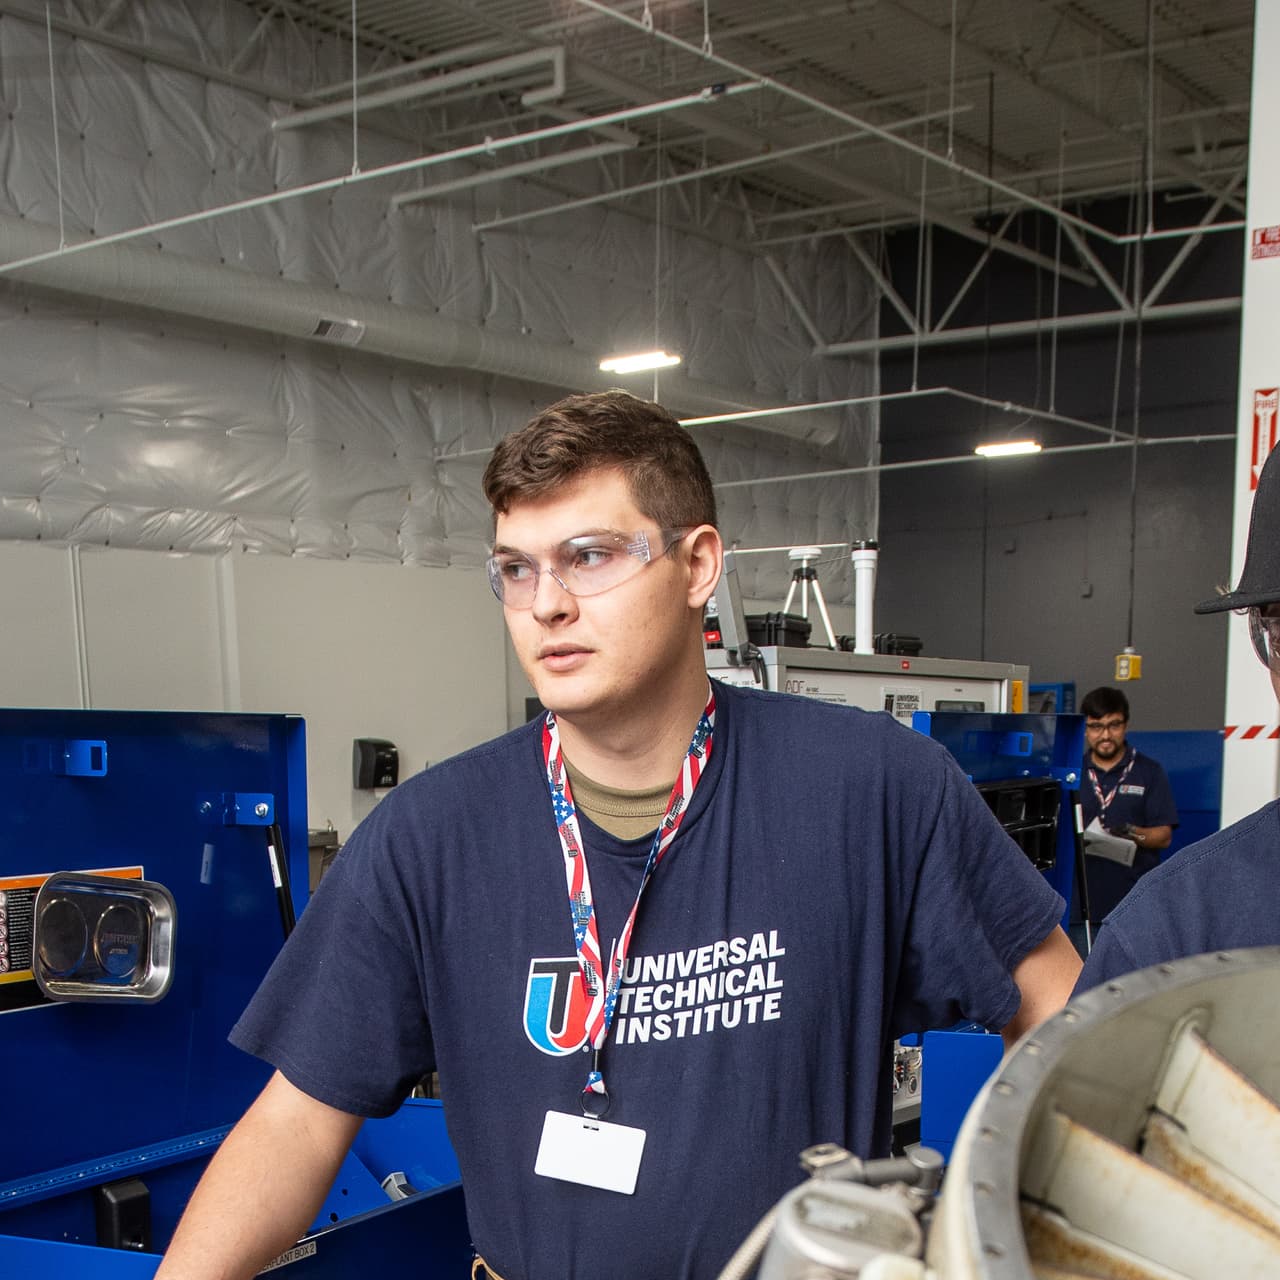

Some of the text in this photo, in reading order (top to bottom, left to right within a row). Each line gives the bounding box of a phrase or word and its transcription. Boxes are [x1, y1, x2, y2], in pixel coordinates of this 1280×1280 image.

[1256, 399, 1278, 409] FIRE
[621, 930, 786, 984] UNIVERSAL
[619, 961, 784, 1014] TECHNICAL
[615, 992, 782, 1044] INSTITUTE
[294, 1245, 310, 1259] BOX
[309, 1242, 315, 1253] 2
